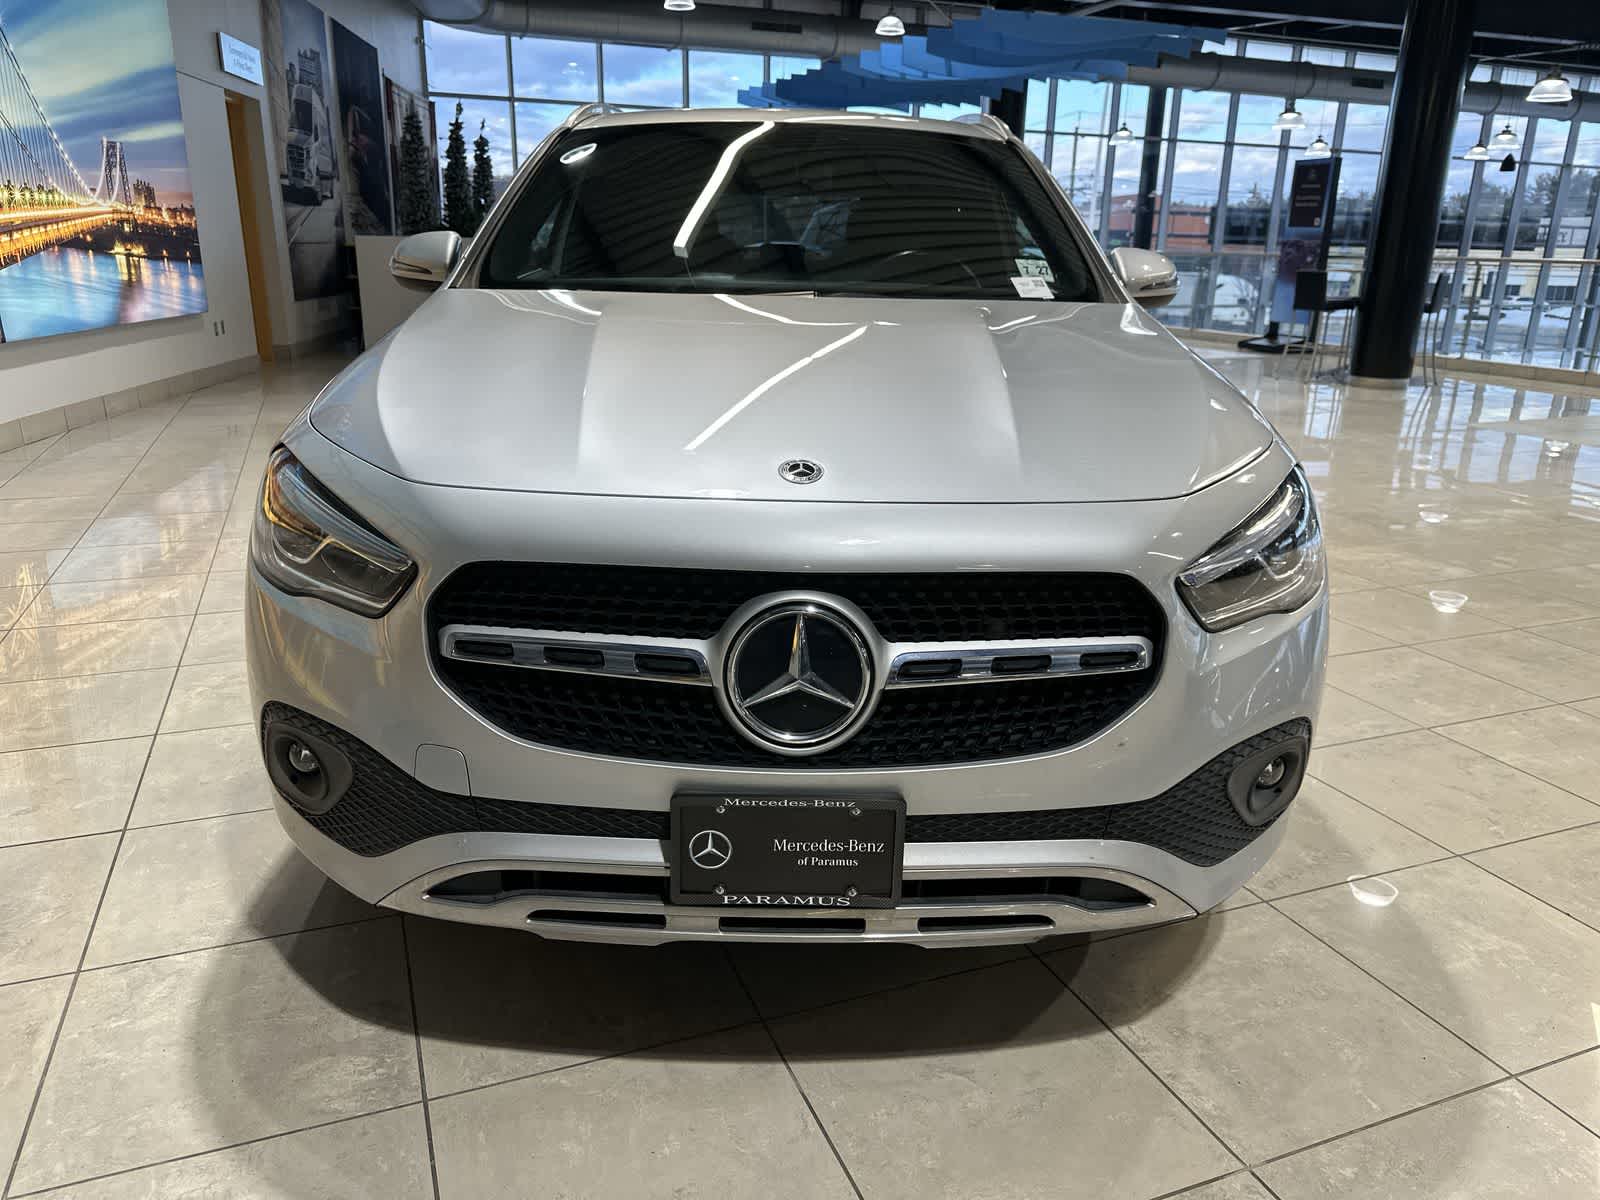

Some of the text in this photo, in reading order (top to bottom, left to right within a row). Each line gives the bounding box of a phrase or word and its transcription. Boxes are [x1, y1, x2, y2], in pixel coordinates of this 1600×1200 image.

[723, 798, 857, 808] Mercedes-Benz
[773, 839, 885, 853] Mercedes-Benz
[797, 856, 859, 867] of Paramus
[722, 895, 851, 906] PARAMUS
